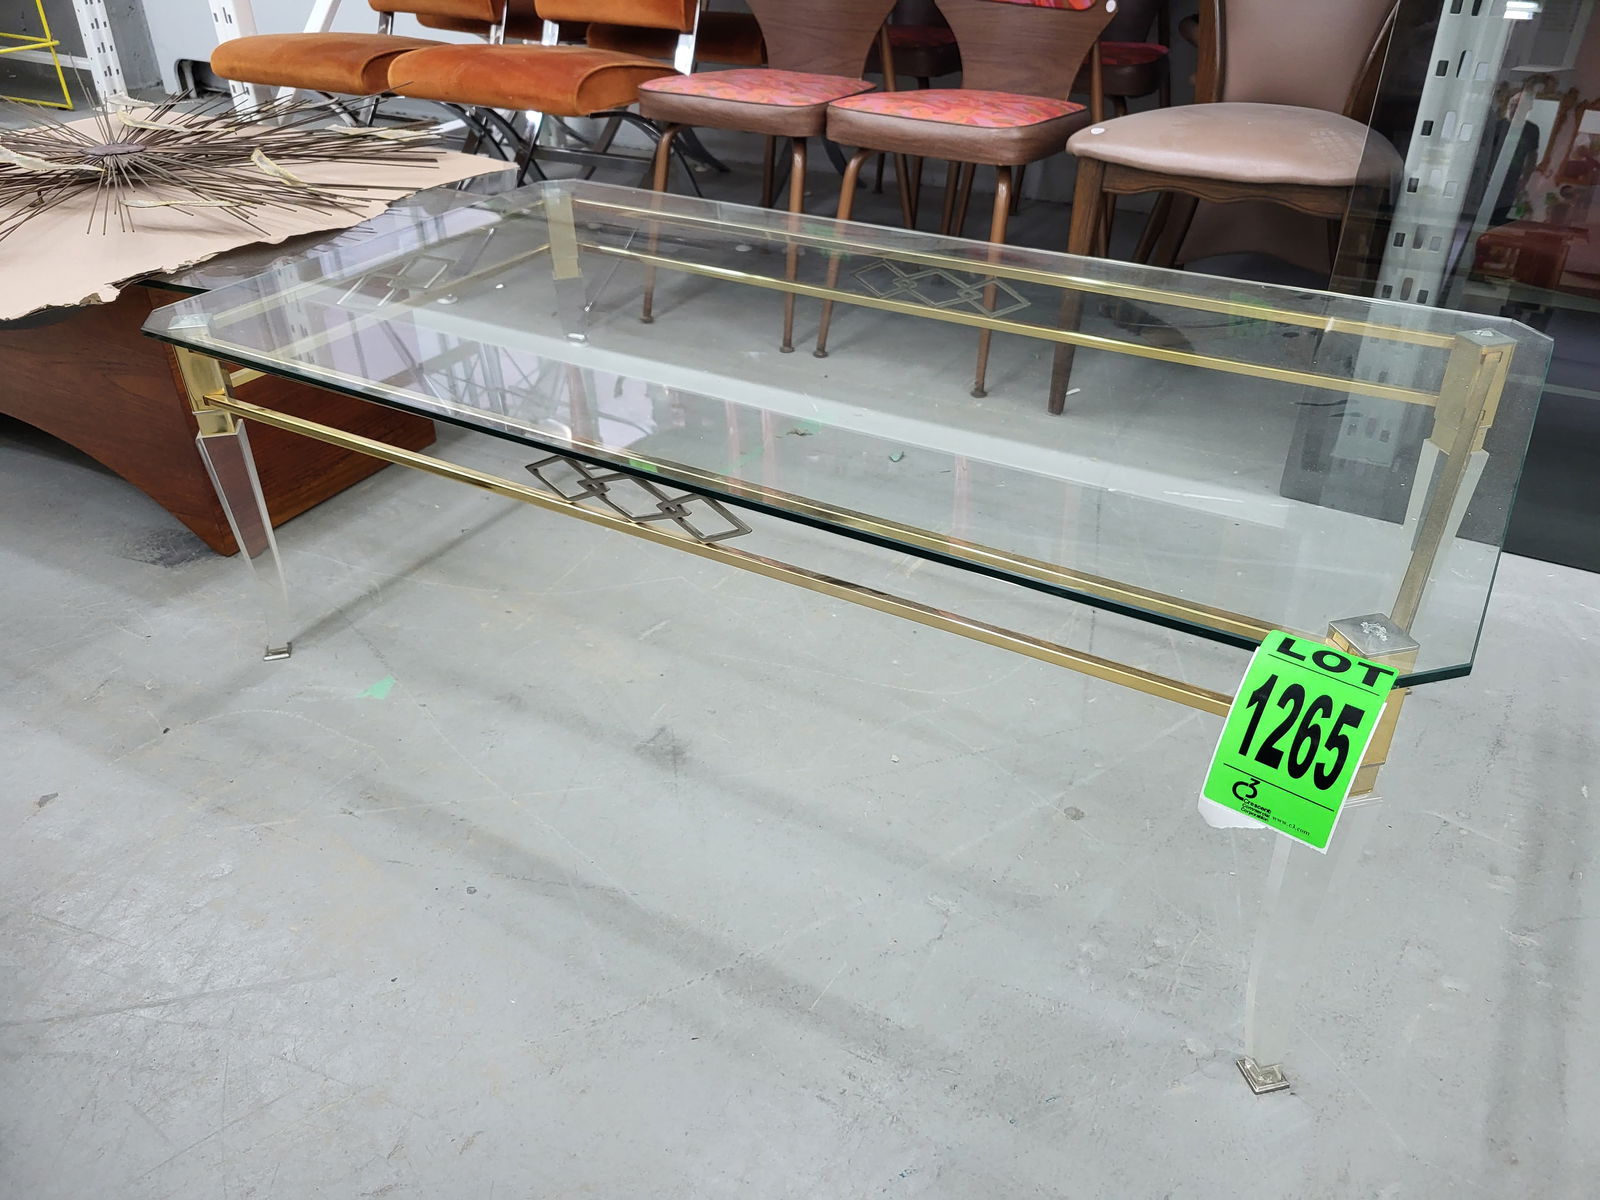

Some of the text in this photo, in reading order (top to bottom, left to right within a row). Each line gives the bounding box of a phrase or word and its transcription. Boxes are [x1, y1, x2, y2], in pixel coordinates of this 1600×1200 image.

[1277, 637, 1394, 687] LOT
[1238, 674, 1365, 790] 1265
[1243, 798, 1271, 814] Crescent
